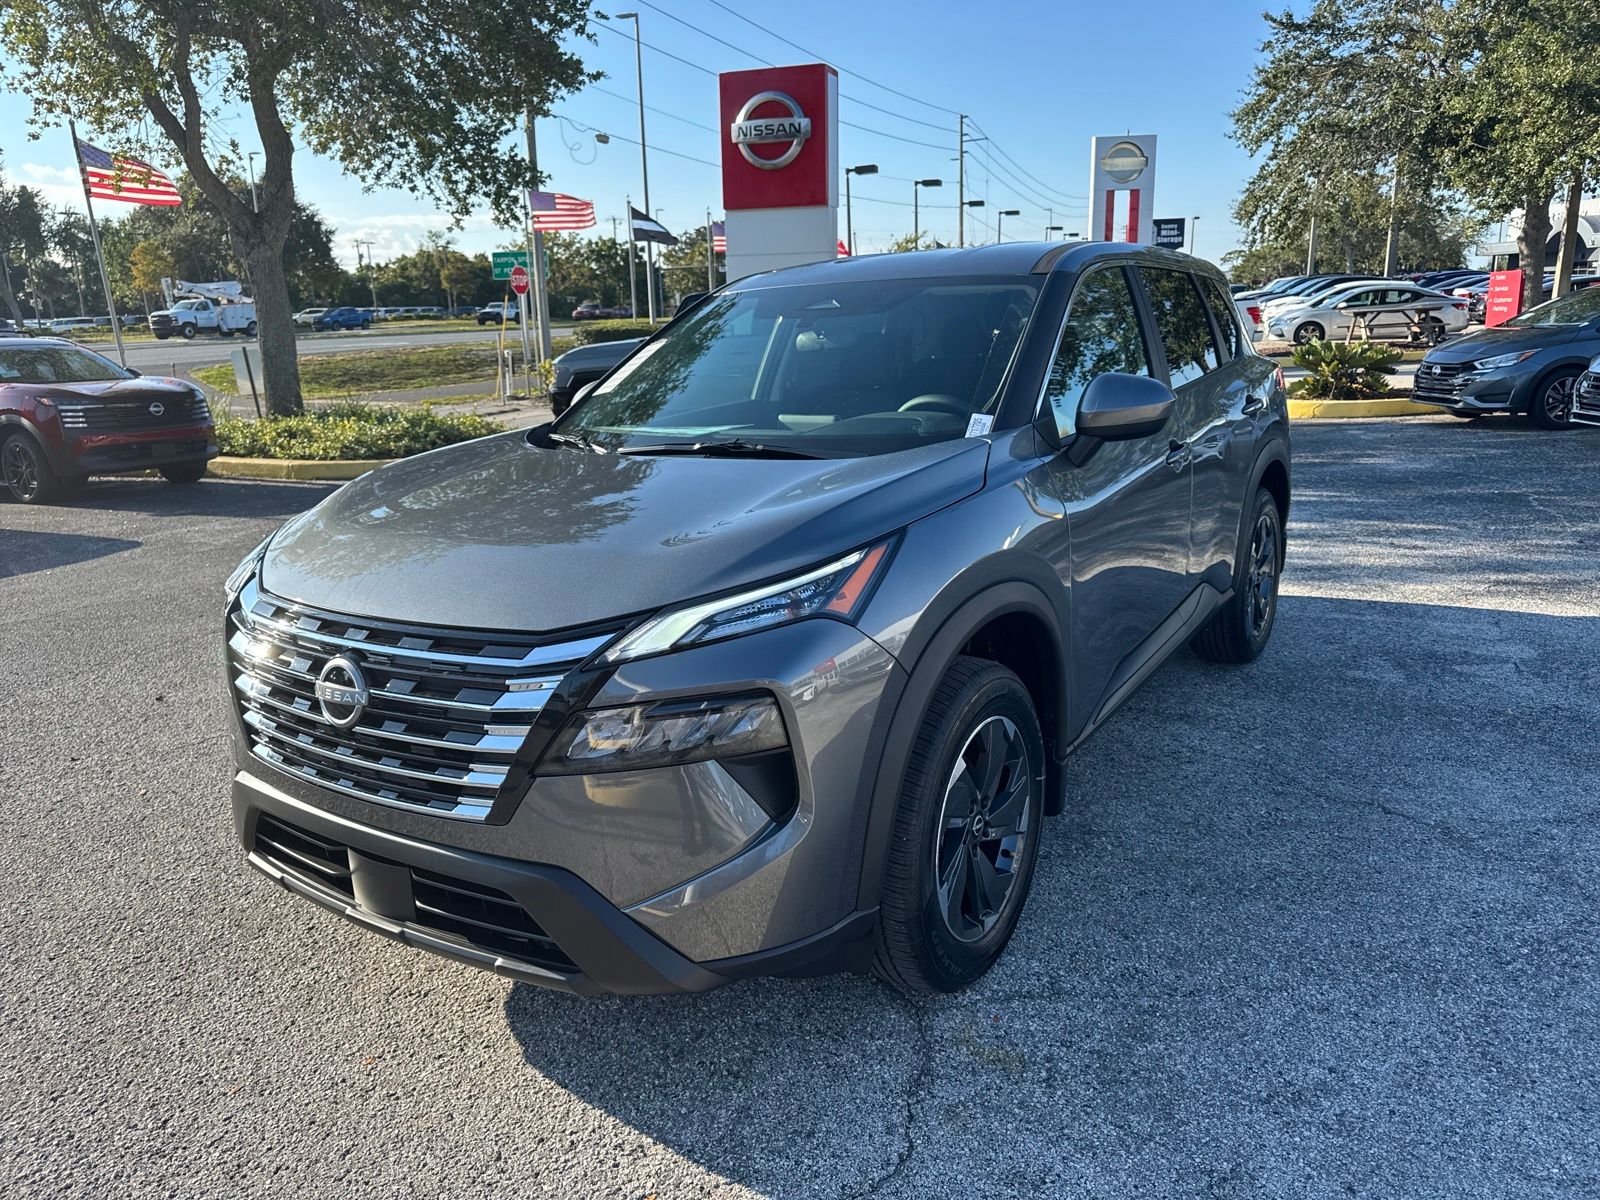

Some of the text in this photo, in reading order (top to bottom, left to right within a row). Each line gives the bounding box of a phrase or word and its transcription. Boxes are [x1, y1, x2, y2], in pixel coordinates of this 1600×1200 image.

[738, 122, 802, 138] NISSAN
[512, 275, 528, 286] STOP
[316, 684, 366, 704] NISSAN
